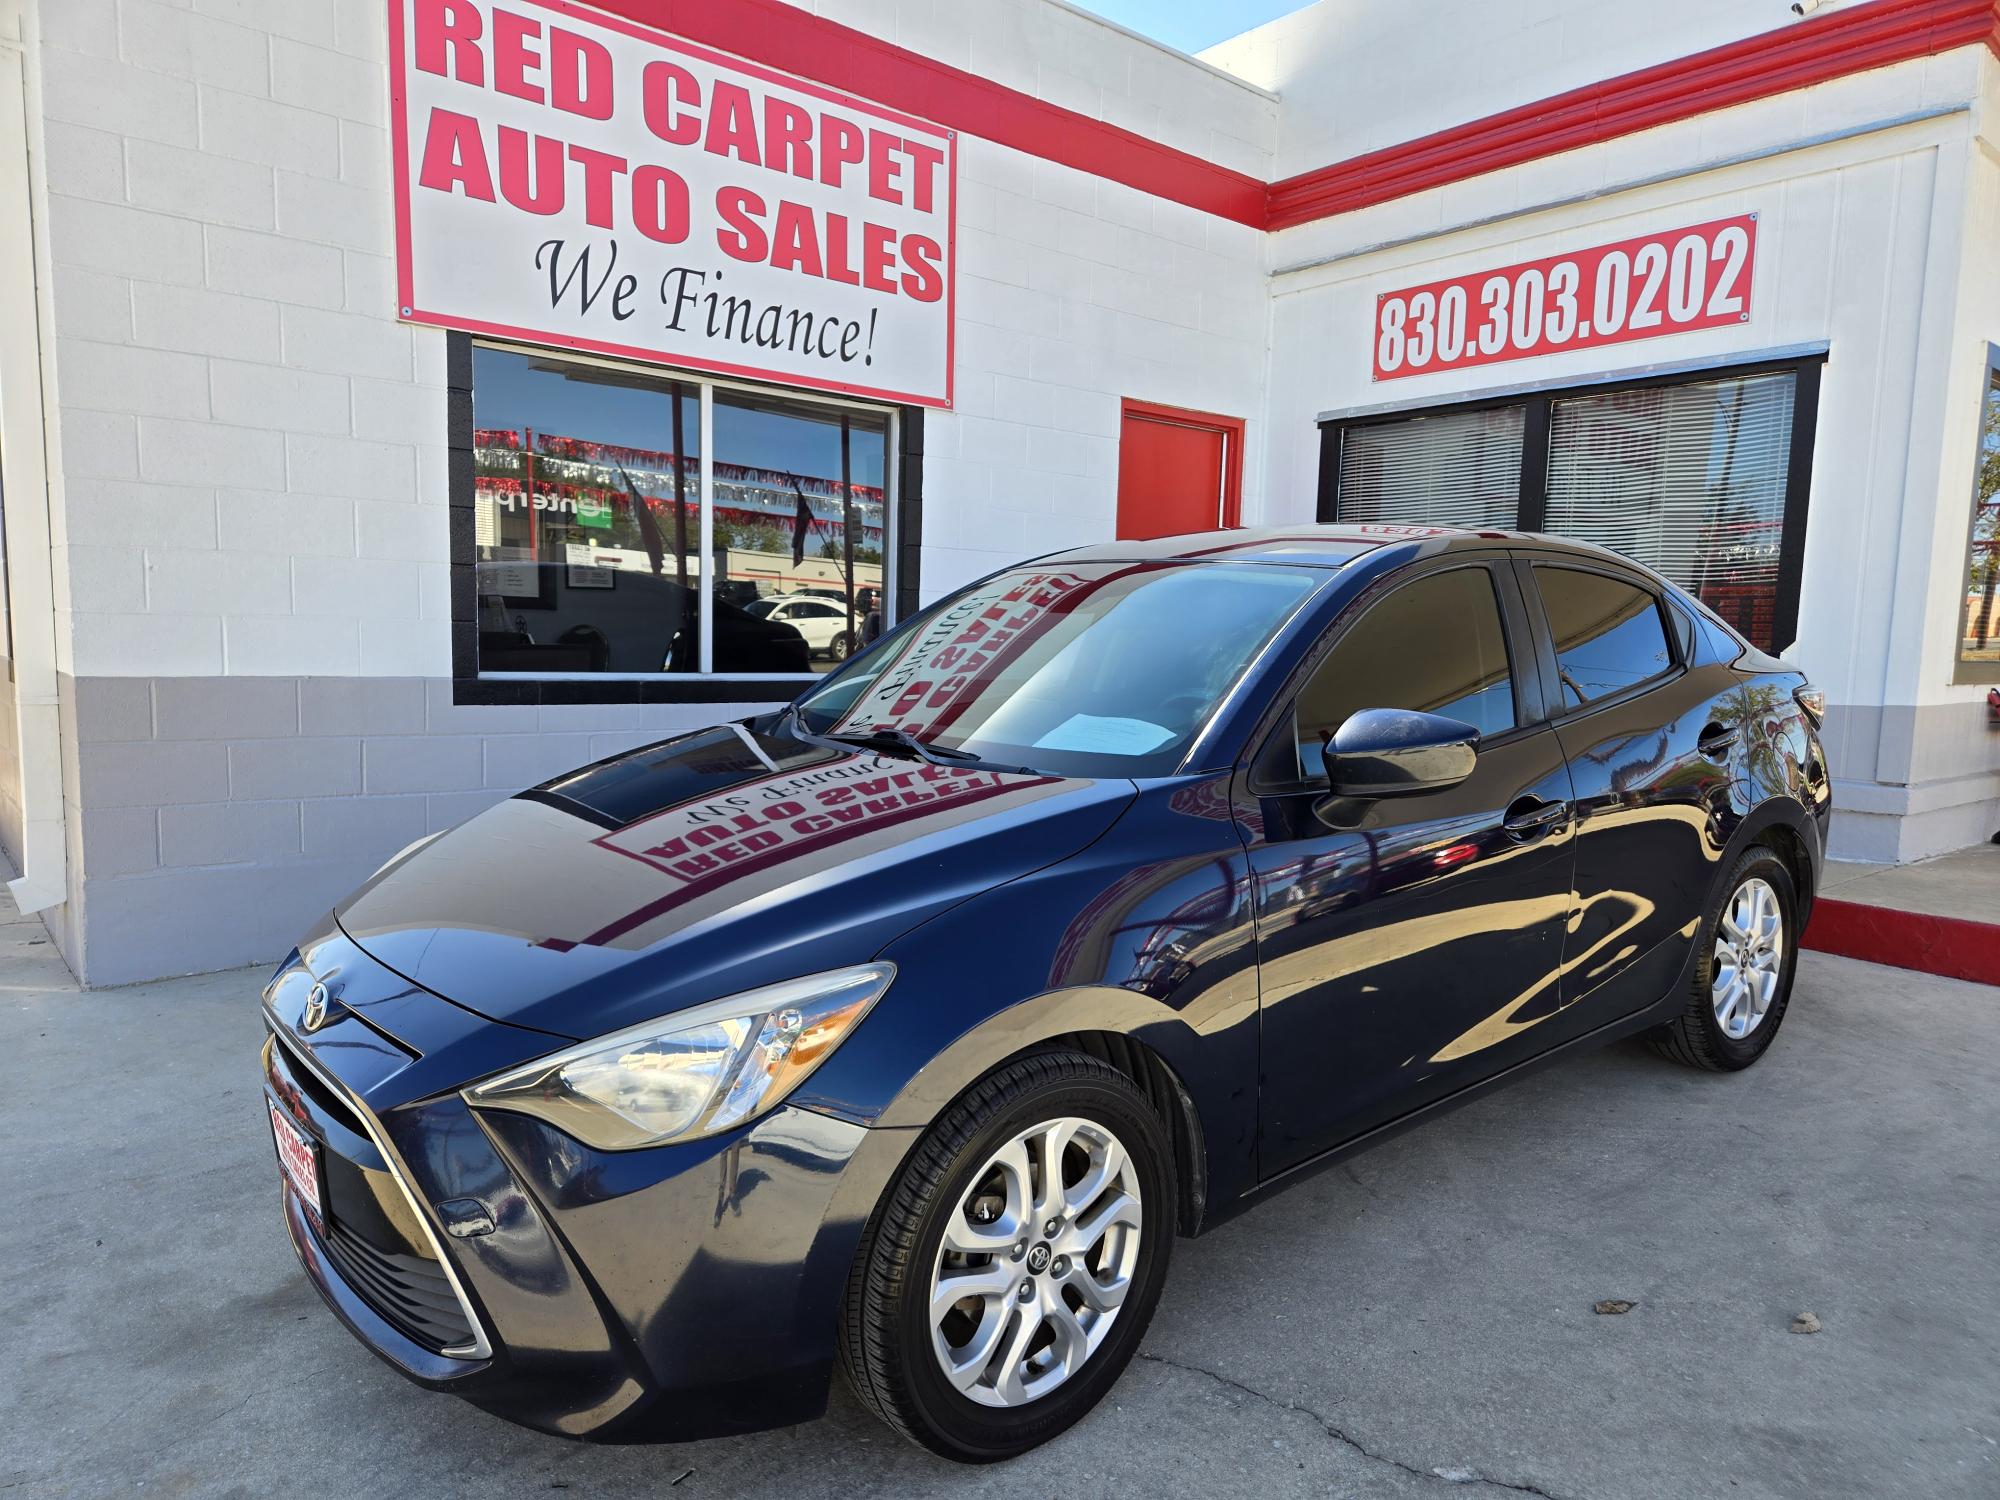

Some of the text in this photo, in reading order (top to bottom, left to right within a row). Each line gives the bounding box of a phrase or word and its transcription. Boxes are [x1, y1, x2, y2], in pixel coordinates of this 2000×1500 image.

[415, 0, 944, 214] RED CARPET
[419, 107, 943, 302] AUTO SALES
[535, 240, 878, 366] We Finance!
[1378, 226, 1749, 372] 830.303.0202
